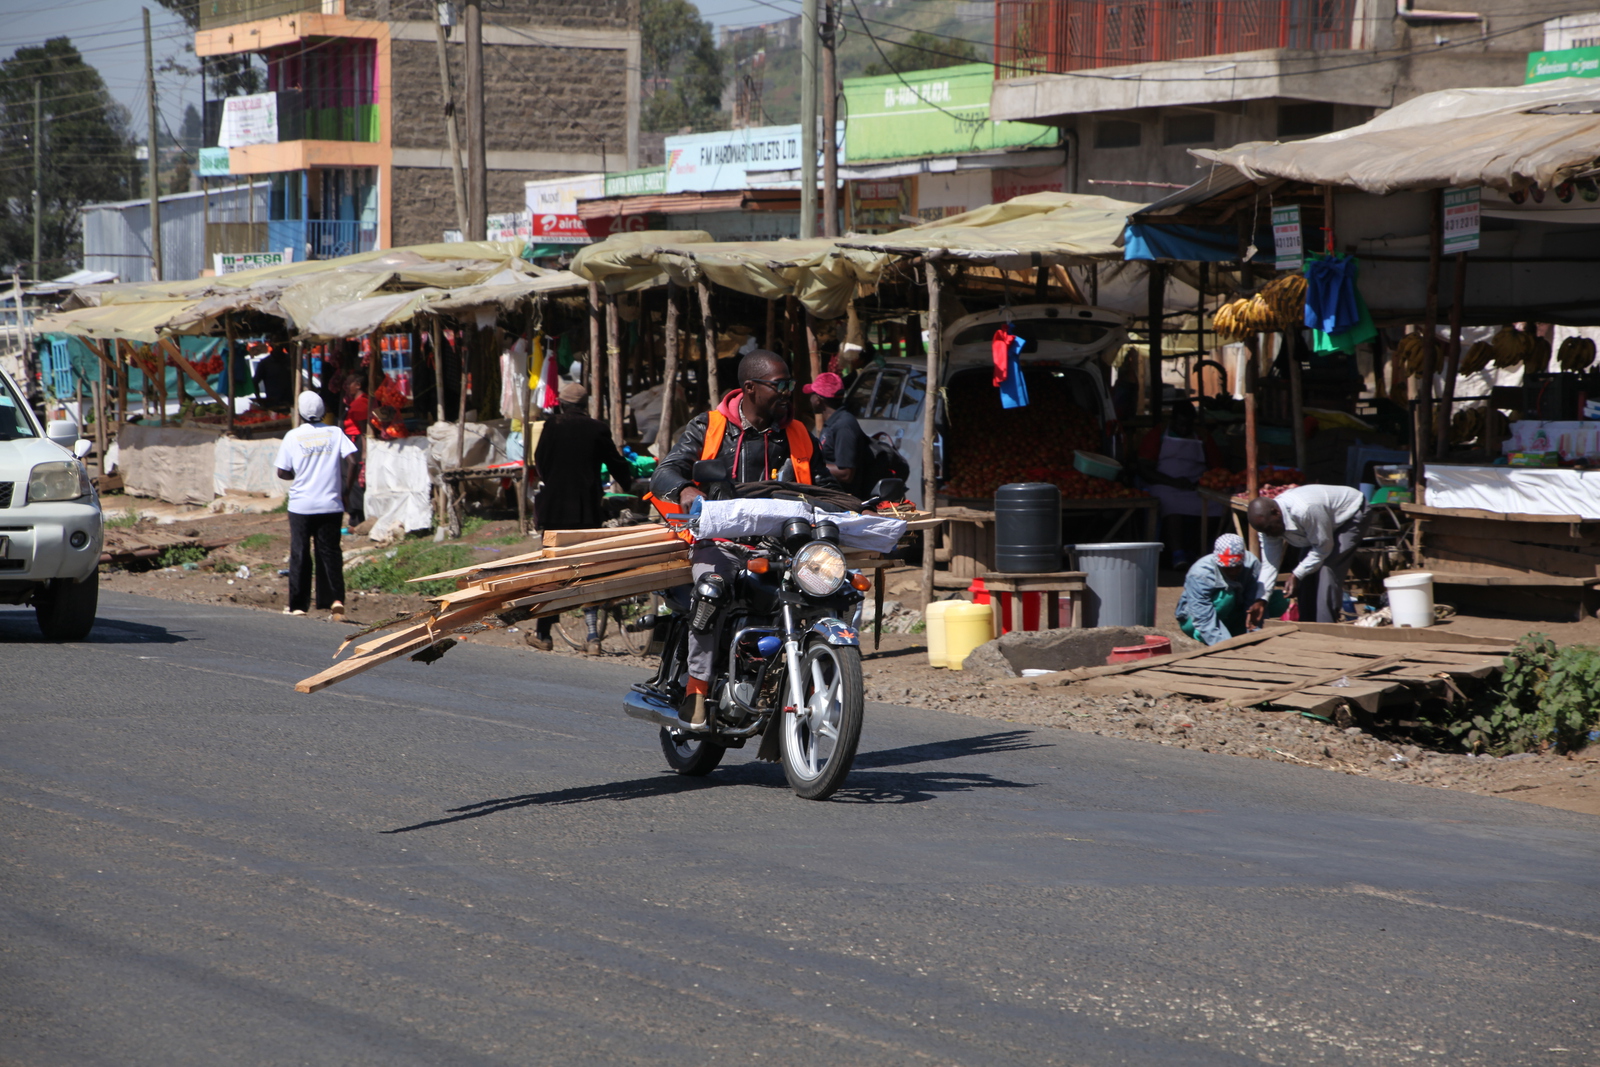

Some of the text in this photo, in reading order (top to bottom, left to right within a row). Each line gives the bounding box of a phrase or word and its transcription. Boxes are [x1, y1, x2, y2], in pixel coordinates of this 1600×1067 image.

[752, 141, 779, 161] OUTLETS
[558, 216, 588, 229] airtel
[609, 215, 645, 233] 4G
